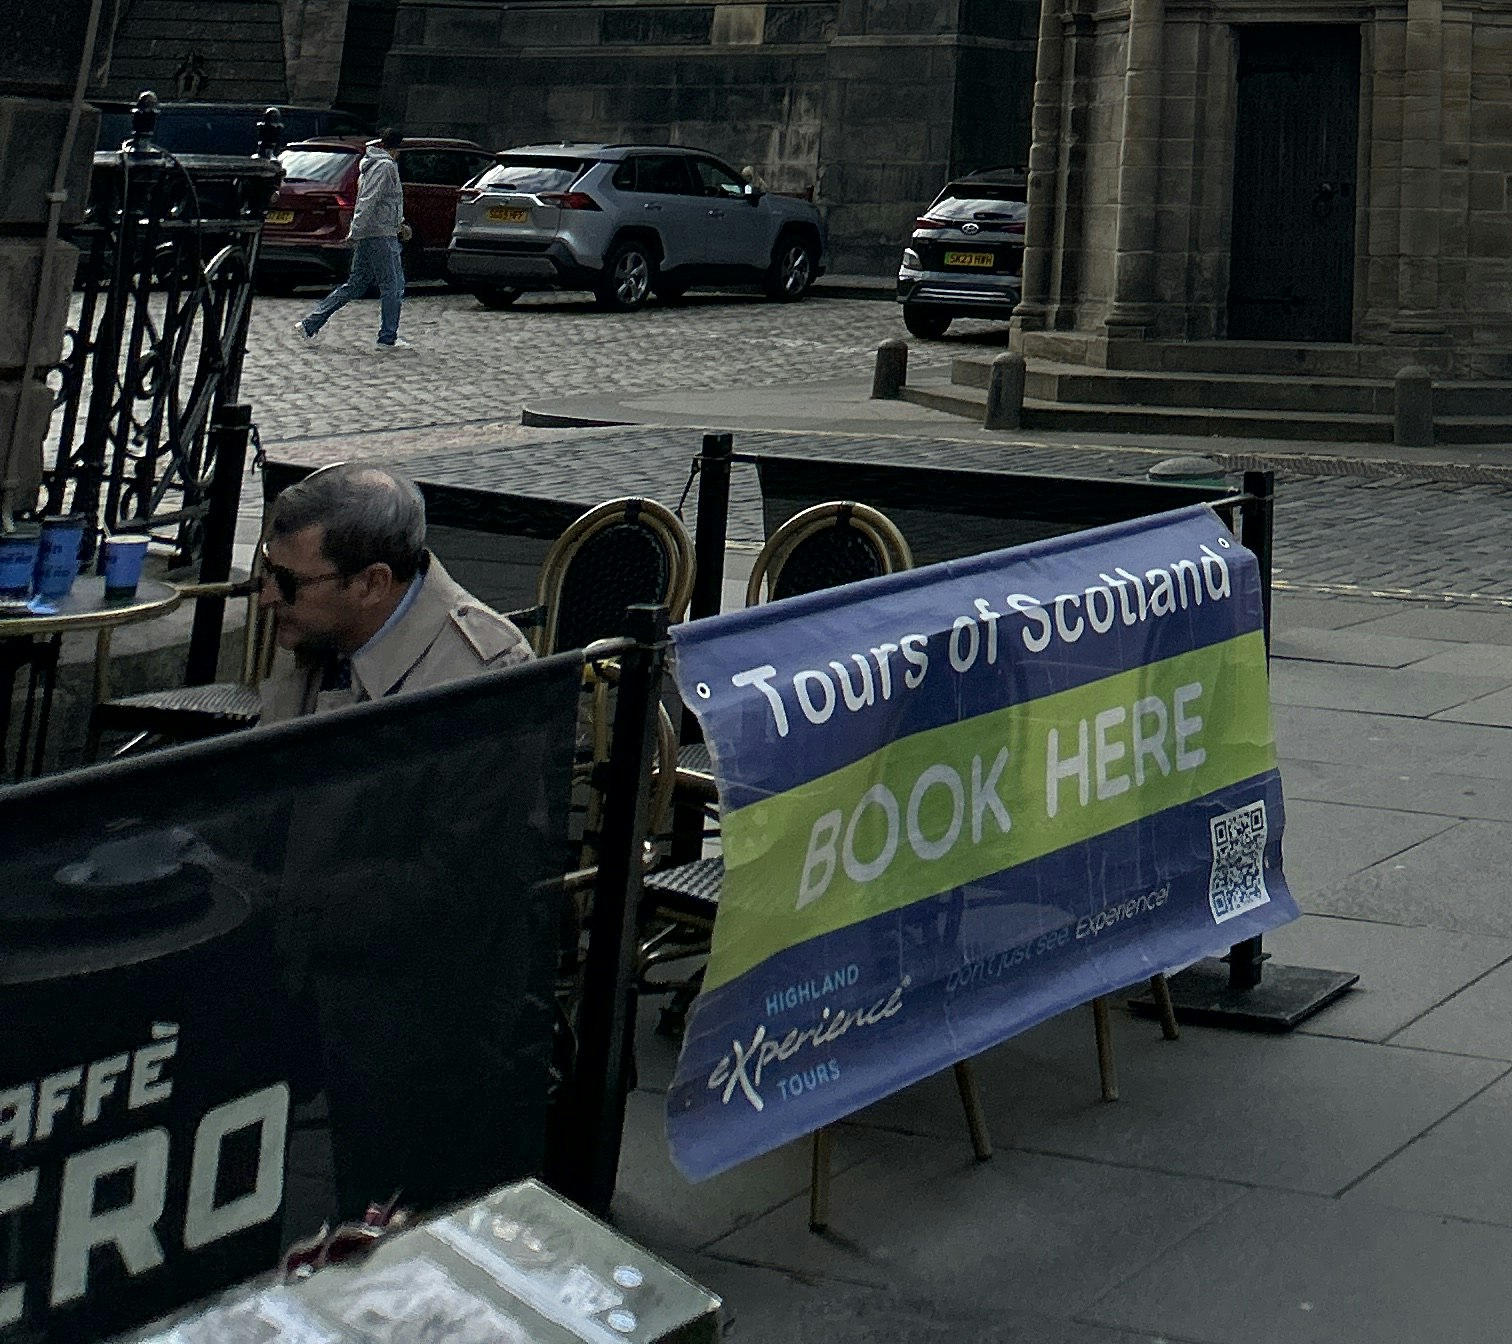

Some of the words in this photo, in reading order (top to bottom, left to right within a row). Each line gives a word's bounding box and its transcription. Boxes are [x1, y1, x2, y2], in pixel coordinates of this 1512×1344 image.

[732, 632, 928, 738] Tours
[948, 597, 1001, 673] of
[1003, 545, 1232, 655] Scotland
[795, 745, 1013, 912] BOOK
[1046, 681, 1207, 818] HERE
[765, 964, 859, 1017] HIGHLAND
[776, 1057, 842, 1101] TOURS
